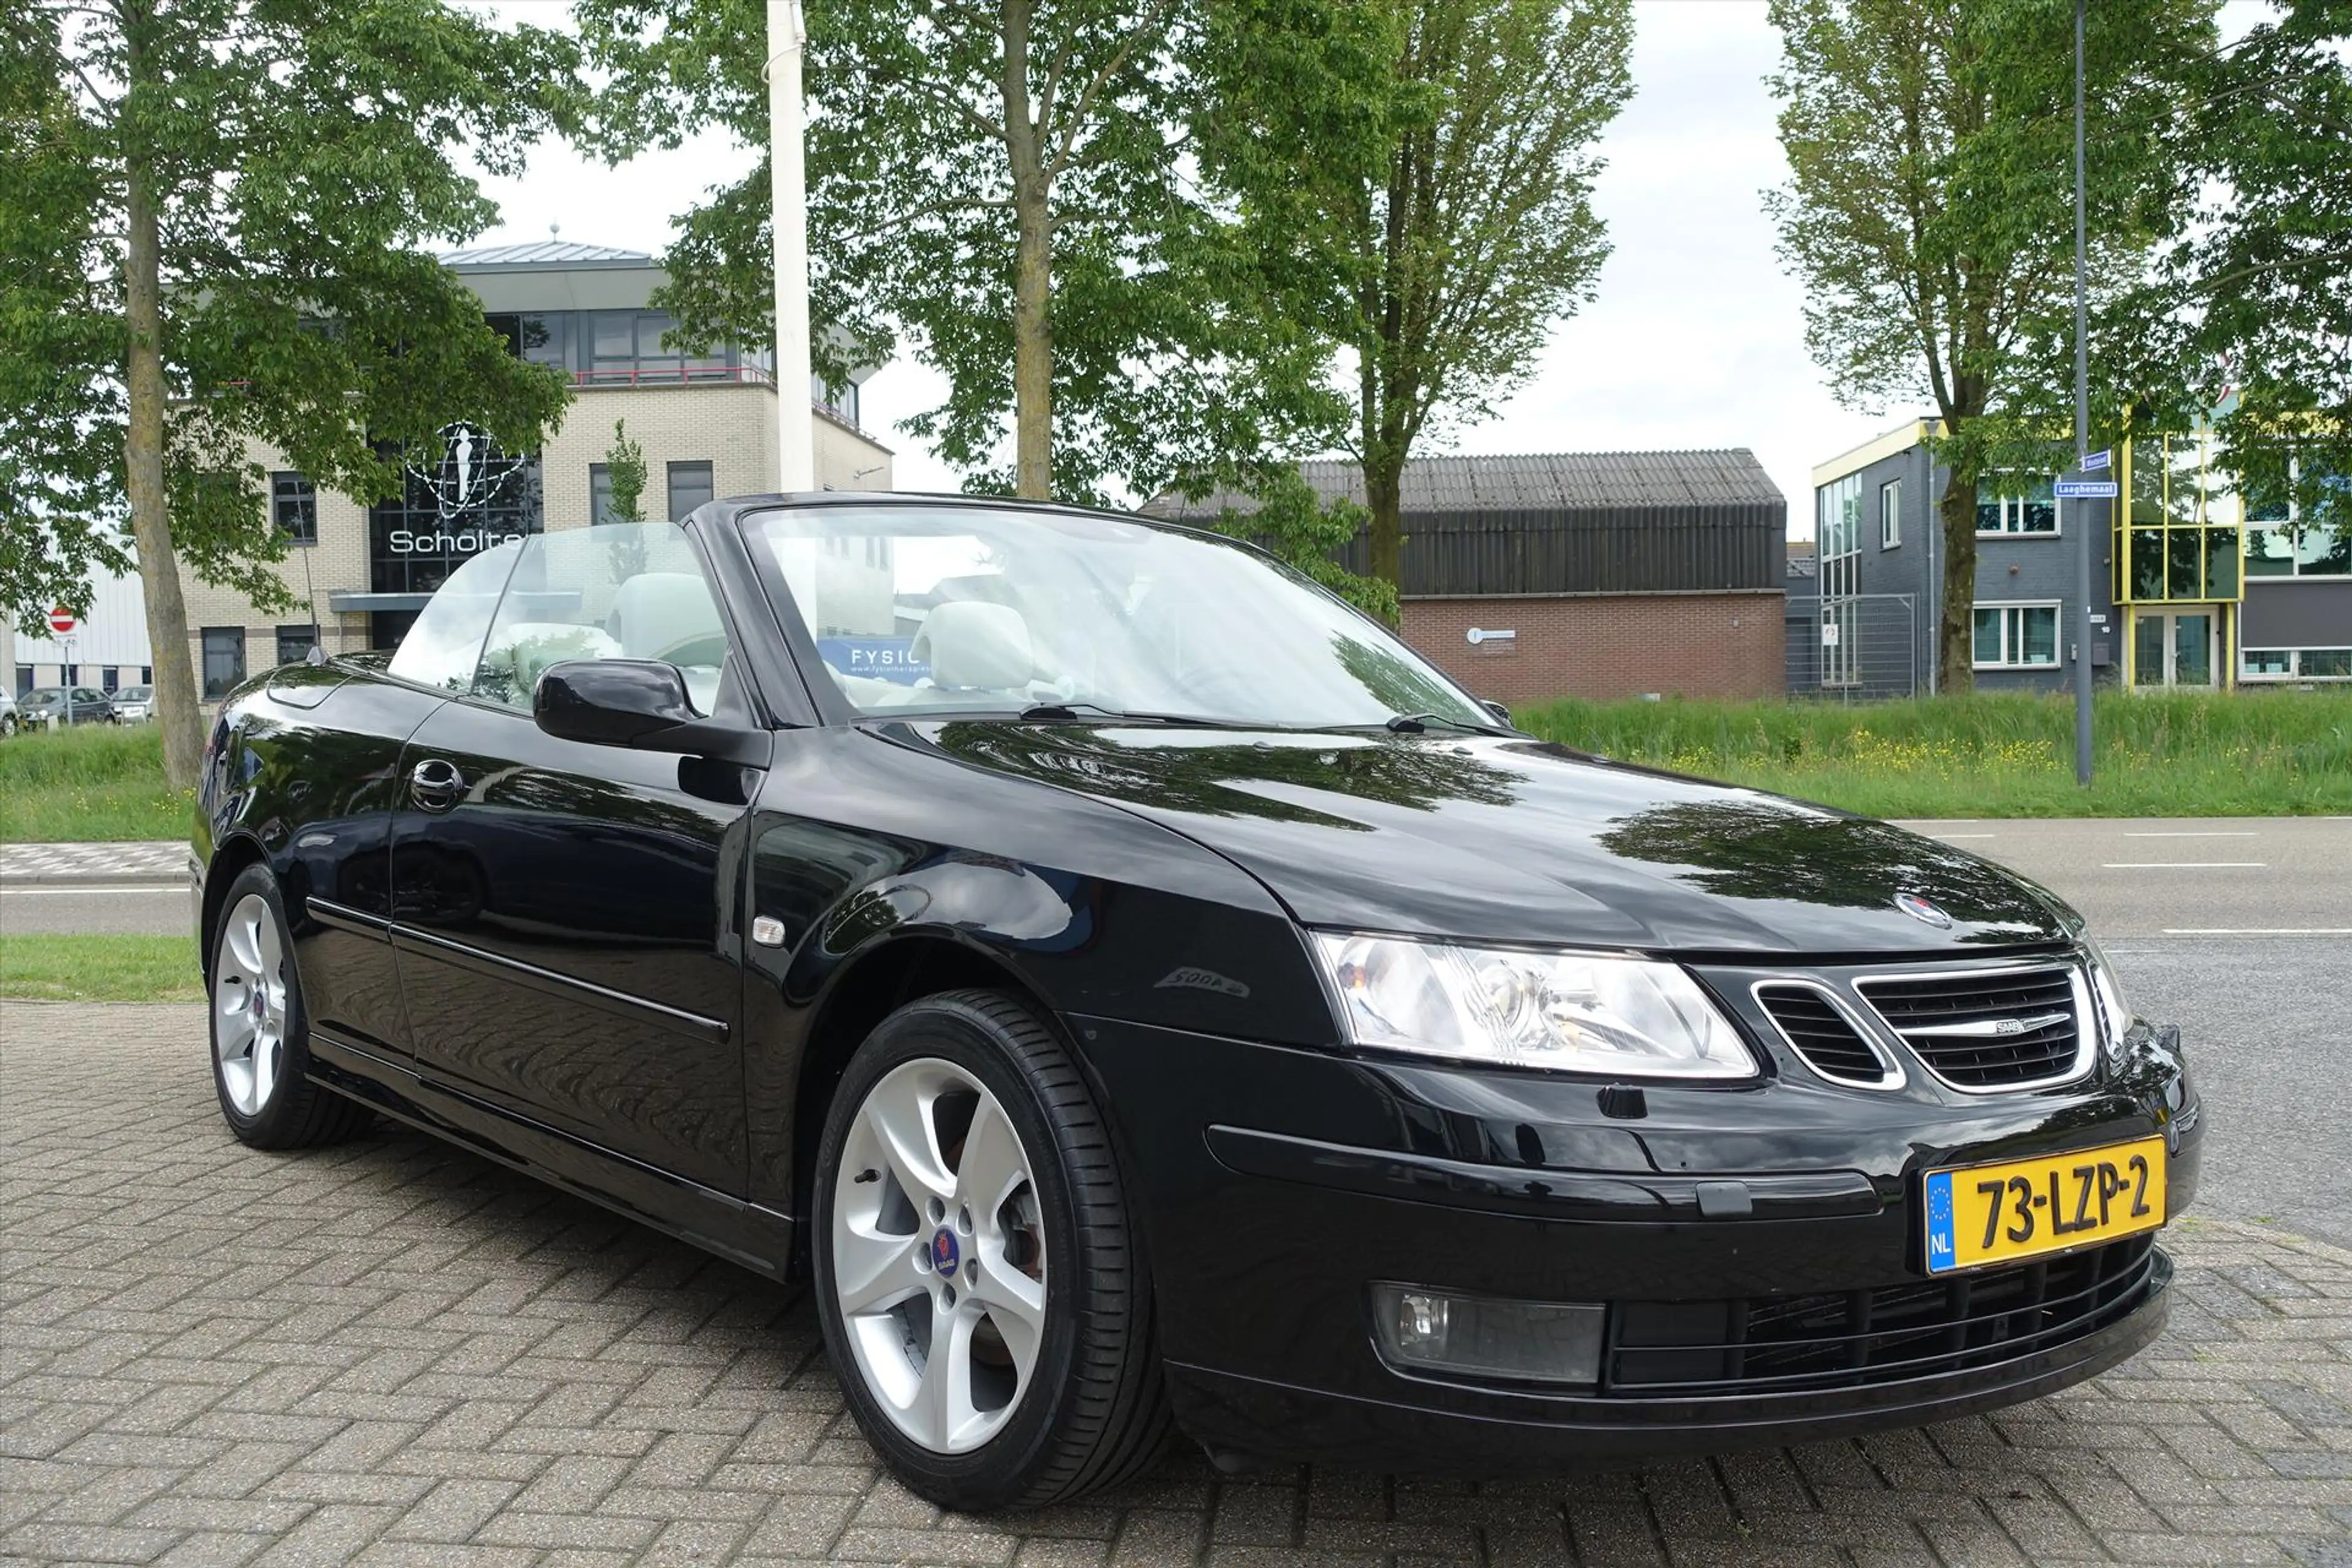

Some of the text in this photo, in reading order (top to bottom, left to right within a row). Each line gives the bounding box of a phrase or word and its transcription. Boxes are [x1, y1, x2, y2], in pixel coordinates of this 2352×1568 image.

[2058, 484, 2113, 495] Laaghemaal
[1977, 1154, 2150, 1250] 73-LZP-2
[1931, 1233, 1951, 1256] NL
